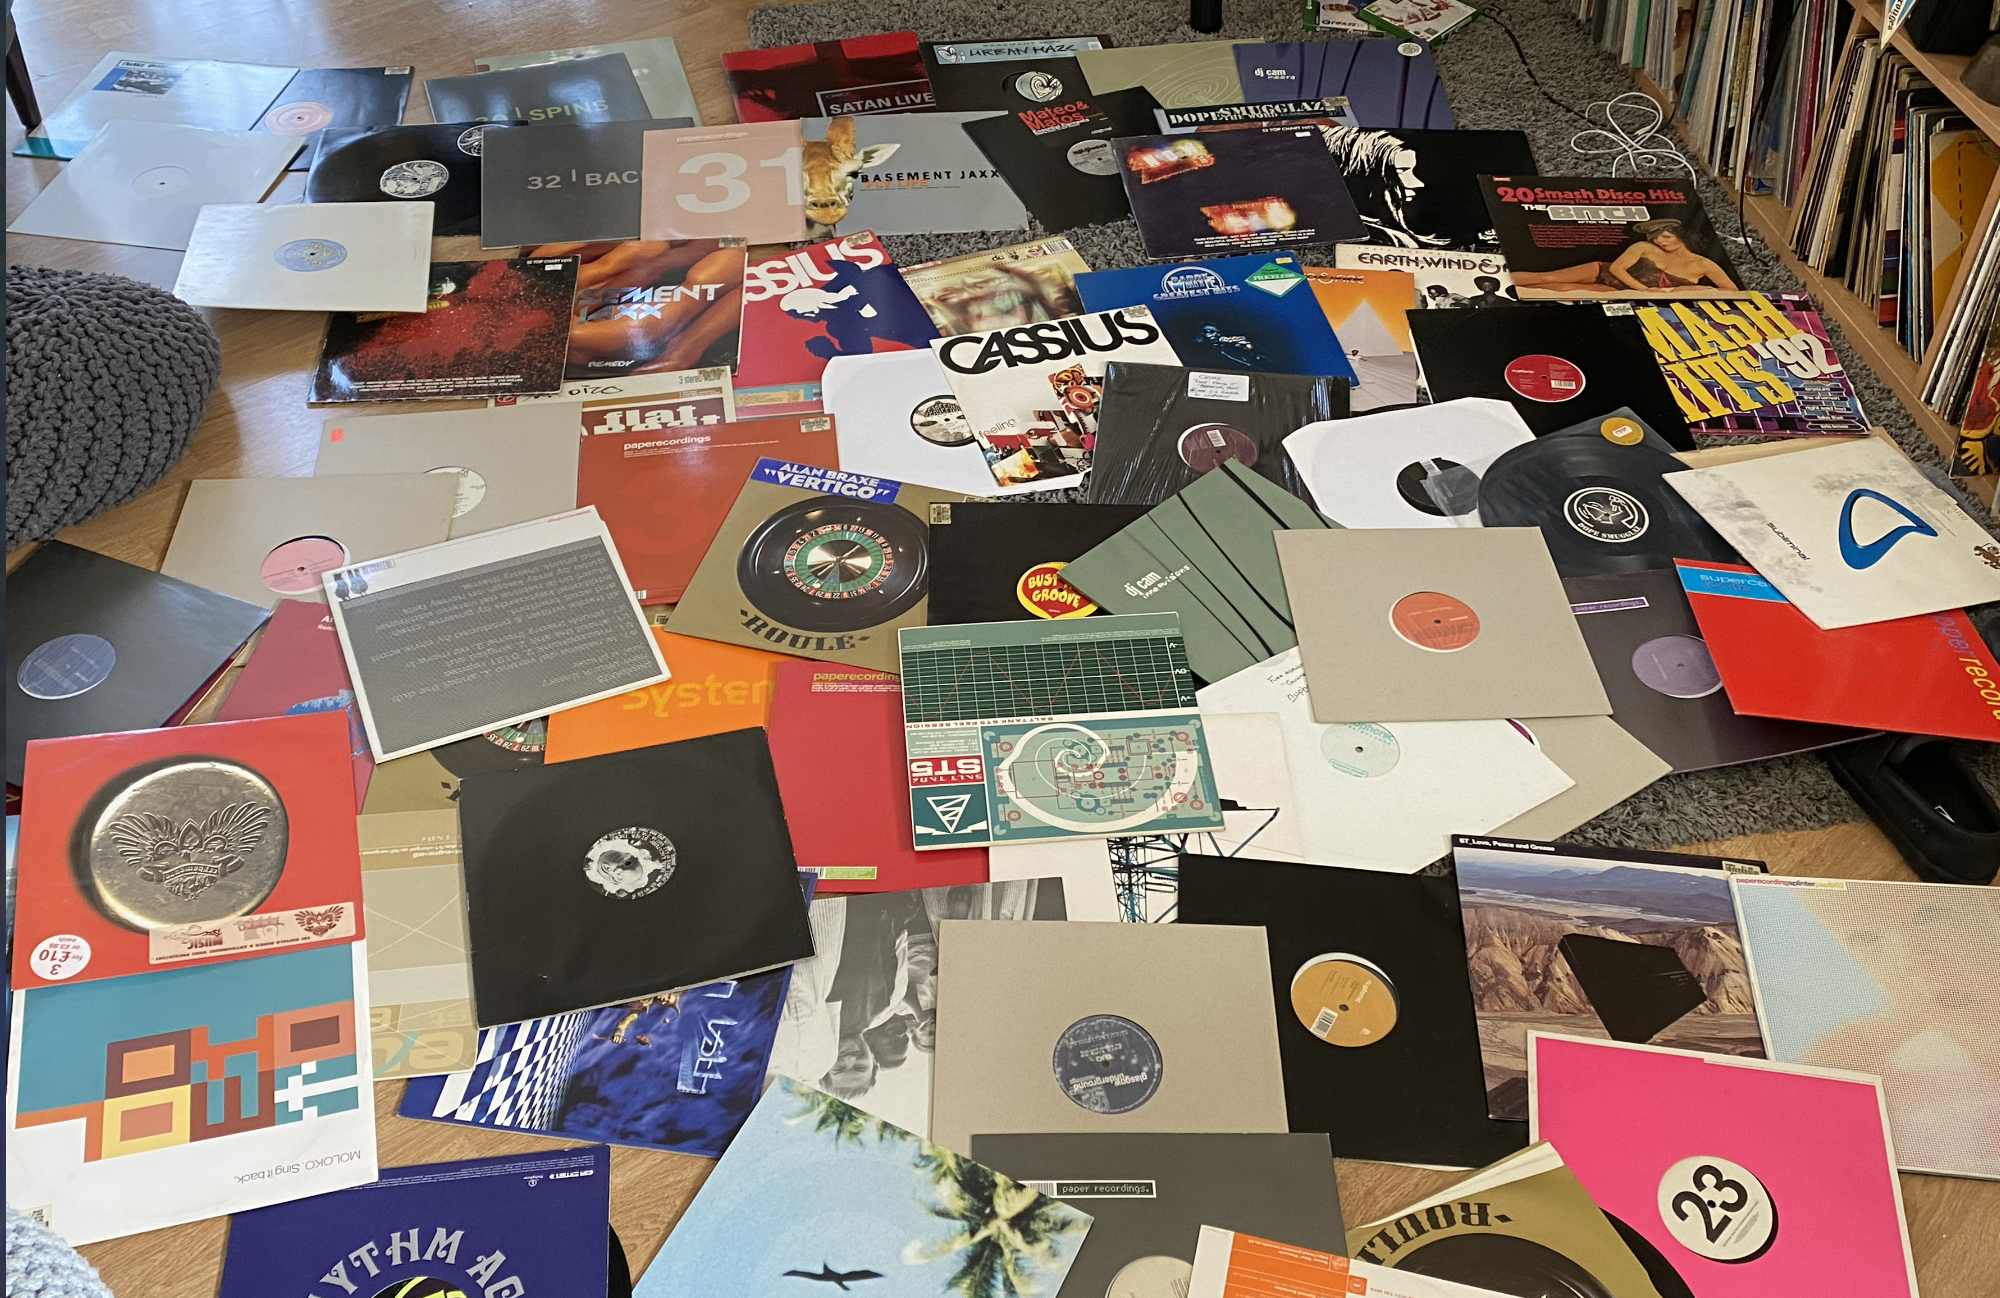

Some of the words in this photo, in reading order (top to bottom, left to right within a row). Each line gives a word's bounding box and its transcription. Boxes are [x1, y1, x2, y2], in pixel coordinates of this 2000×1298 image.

[1254, 68, 1264, 78] dj
[1266, 69, 1286, 77] cam
[529, 100, 609, 121] SPINS
[830, 98, 892, 114] SATAN
[895, 92, 935, 106] LIVE
[1218, 101, 1324, 116] SMUGGLAZ
[1027, 113, 1084, 130] Matos
[527, 175, 561, 189] 32
[585, 170, 642, 187] BAC
[676, 147, 804, 213] 31
[861, 171, 951, 183] BASEMENT
[960, 169, 999, 180] JAXX
[1497, 187, 1535, 202] 20
[1534, 188, 1591, 201] Smash
[1596, 188, 1646, 201] Disco
[1648, 189, 1684, 201] Hits
[1549, 206, 1649, 221] BITCH
[1153, 288, 1210, 300] GREATEST
[1213, 284, 1241, 295] HITS
[1167, 275, 1217, 294] WHITE
[1634, 290, 1804, 364] MASH
[939, 312, 1160, 375] CASSIUS
[588, 360, 635, 369] REMEDY
[978, 417, 1016, 441] feeling
[624, 435, 711, 450] paperecordings
[780, 462, 825, 478] ALAN
[825, 470, 880, 487] BRAXE
[1577, 521, 1600, 537] DOPE
[1767, 522, 1810, 561] subliminal
[1027, 573, 1058, 589] BUST
[1124, 582, 1144, 597] dj
[1136, 571, 1161, 590] cam
[1700, 574, 1771, 588] superca
[1032, 588, 1081, 609] GROOVE
[911, 758, 982, 777] ST5
[951, 774, 983, 782] SALT
[1492, 841, 1515, 849] Peace
[1530, 844, 1556, 852] Grease
[186, 935, 223, 950] MUSIC
[38, 948, 69, 964] £10
[69, 953, 83, 962] for
[51, 963, 62, 975] 3
[1073, 1073, 1124, 1090] underground
[1114, 1071, 1148, 1087] glasgow
[302, 1150, 361, 1170] MOLOKO.
[266, 1168, 274, 1179] it
[274, 1163, 300, 1175] Sing
[1062, 1185, 1090, 1194] paper
[1094, 1184, 1150, 1195] recordings.
[1671, 1164, 1748, 1244] 23
